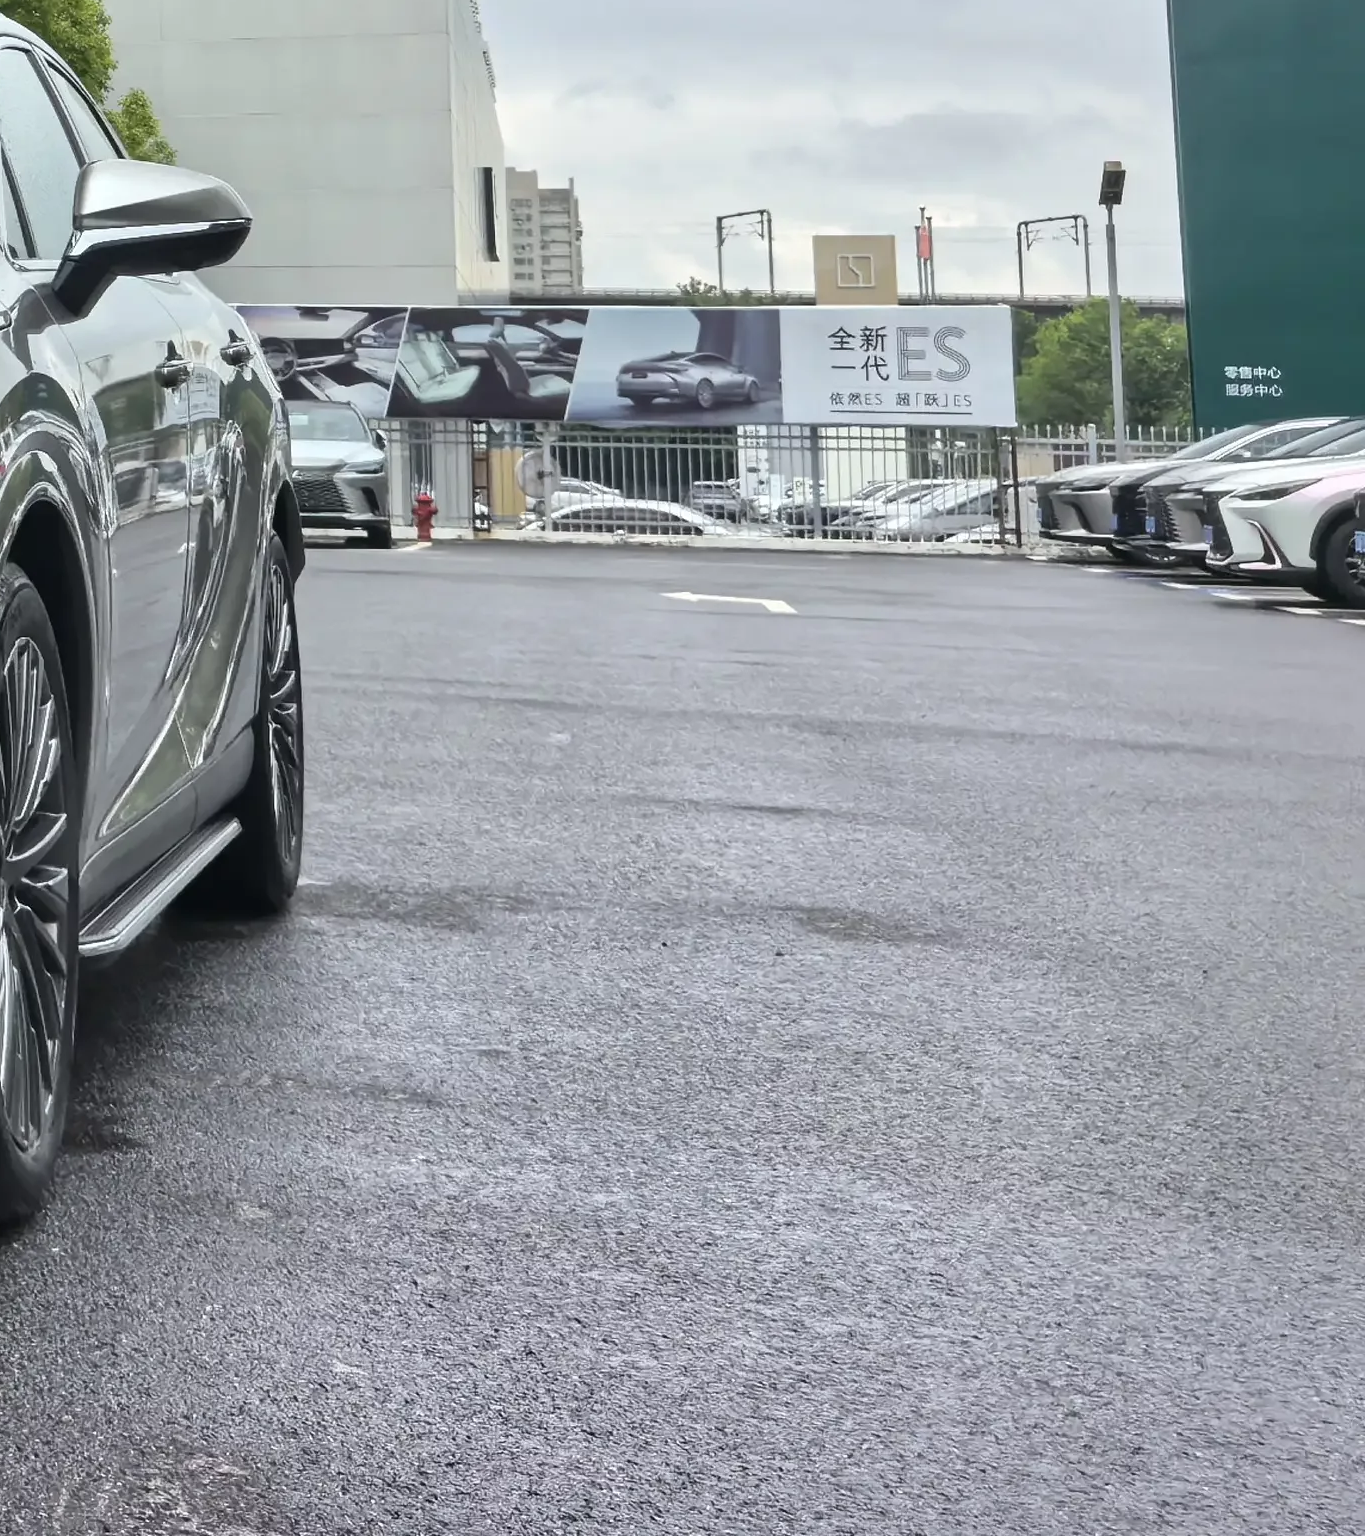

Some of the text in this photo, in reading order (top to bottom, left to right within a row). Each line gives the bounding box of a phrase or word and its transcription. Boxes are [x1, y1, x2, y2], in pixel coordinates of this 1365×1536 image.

[828, 326, 888, 352] 全新
[896, 326, 971, 382] ES
[831, 355, 890, 381] 一代
[1224, 366, 1282, 380] 零售中心
[1225, 384, 1283, 397] 服务中心
